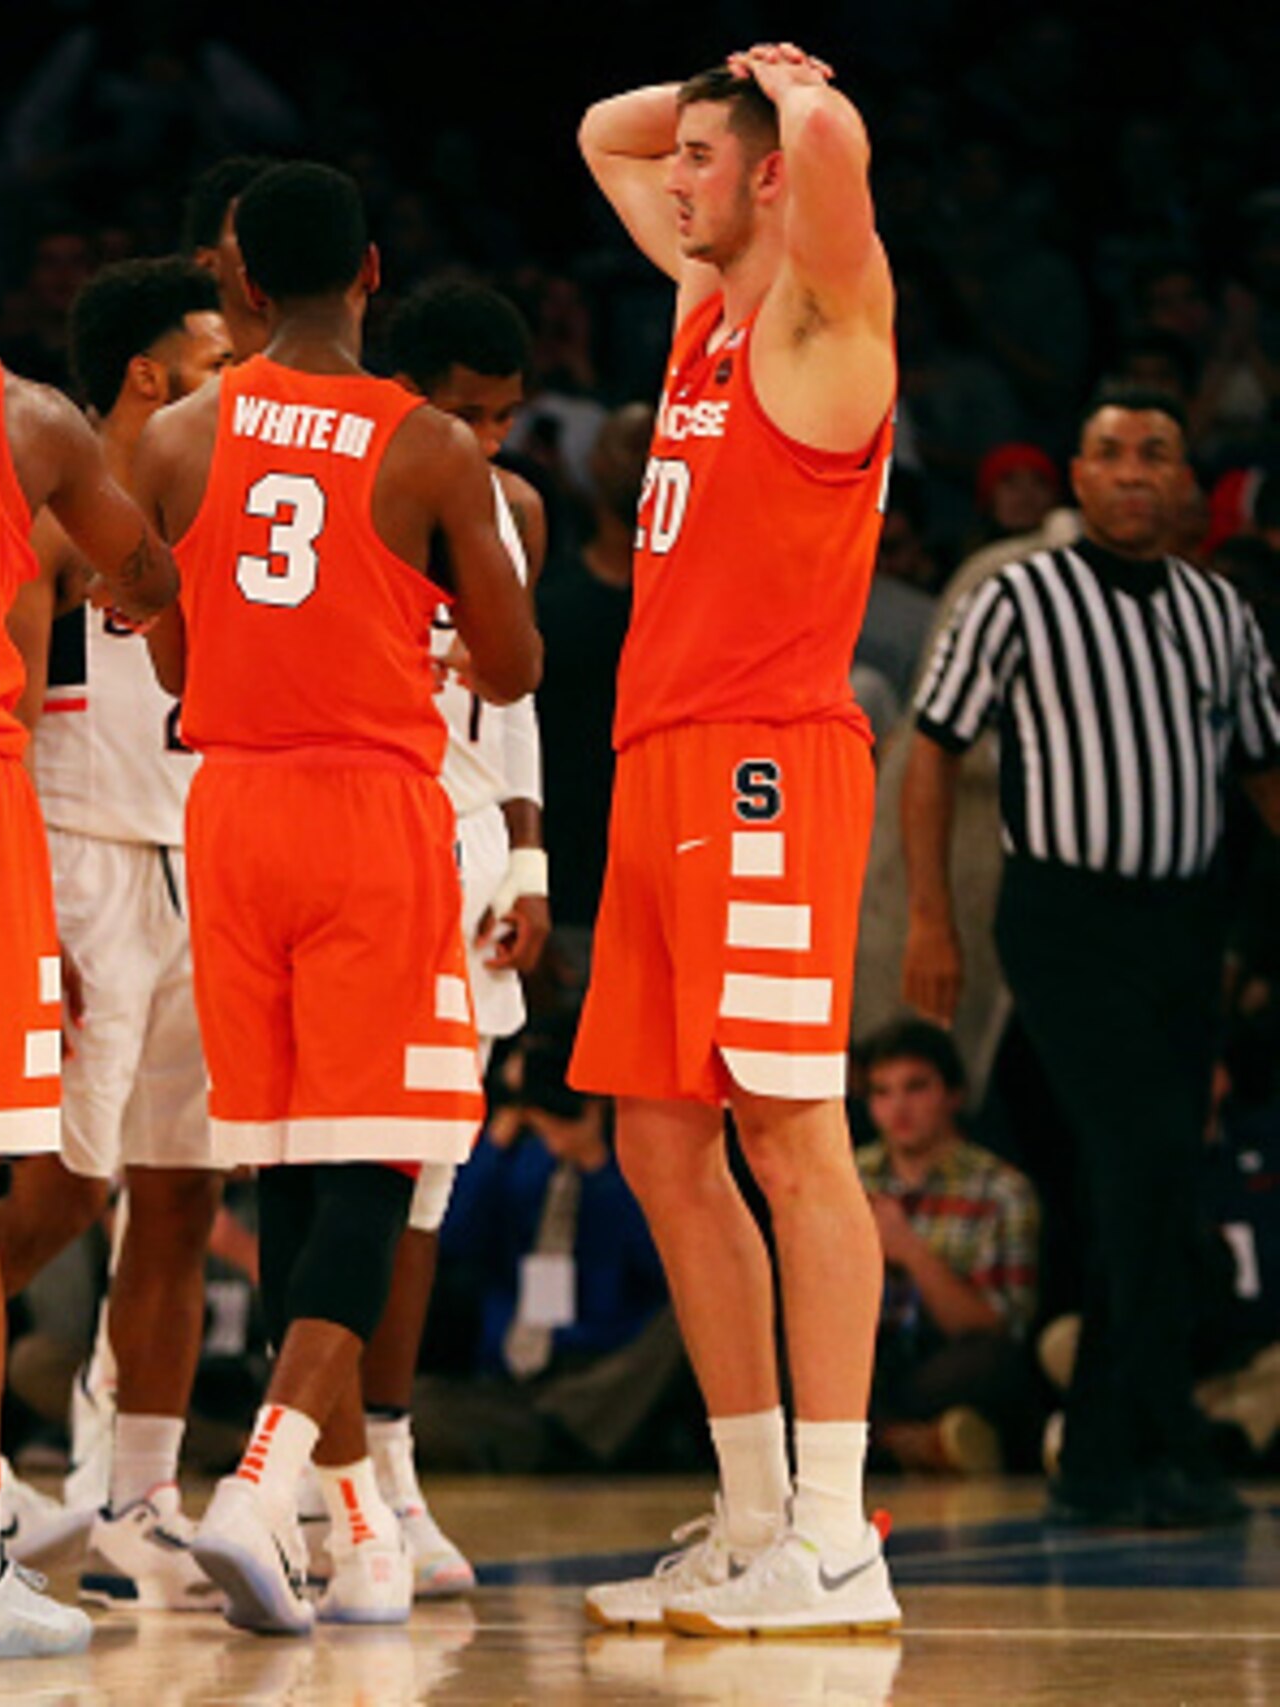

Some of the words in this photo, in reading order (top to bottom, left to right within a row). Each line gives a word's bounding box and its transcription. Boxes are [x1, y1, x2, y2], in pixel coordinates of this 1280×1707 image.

[233, 395, 337, 449] WHITE
[332, 413, 375, 459] III
[236, 472, 326, 608] 3
[732, 758, 785, 824] S
